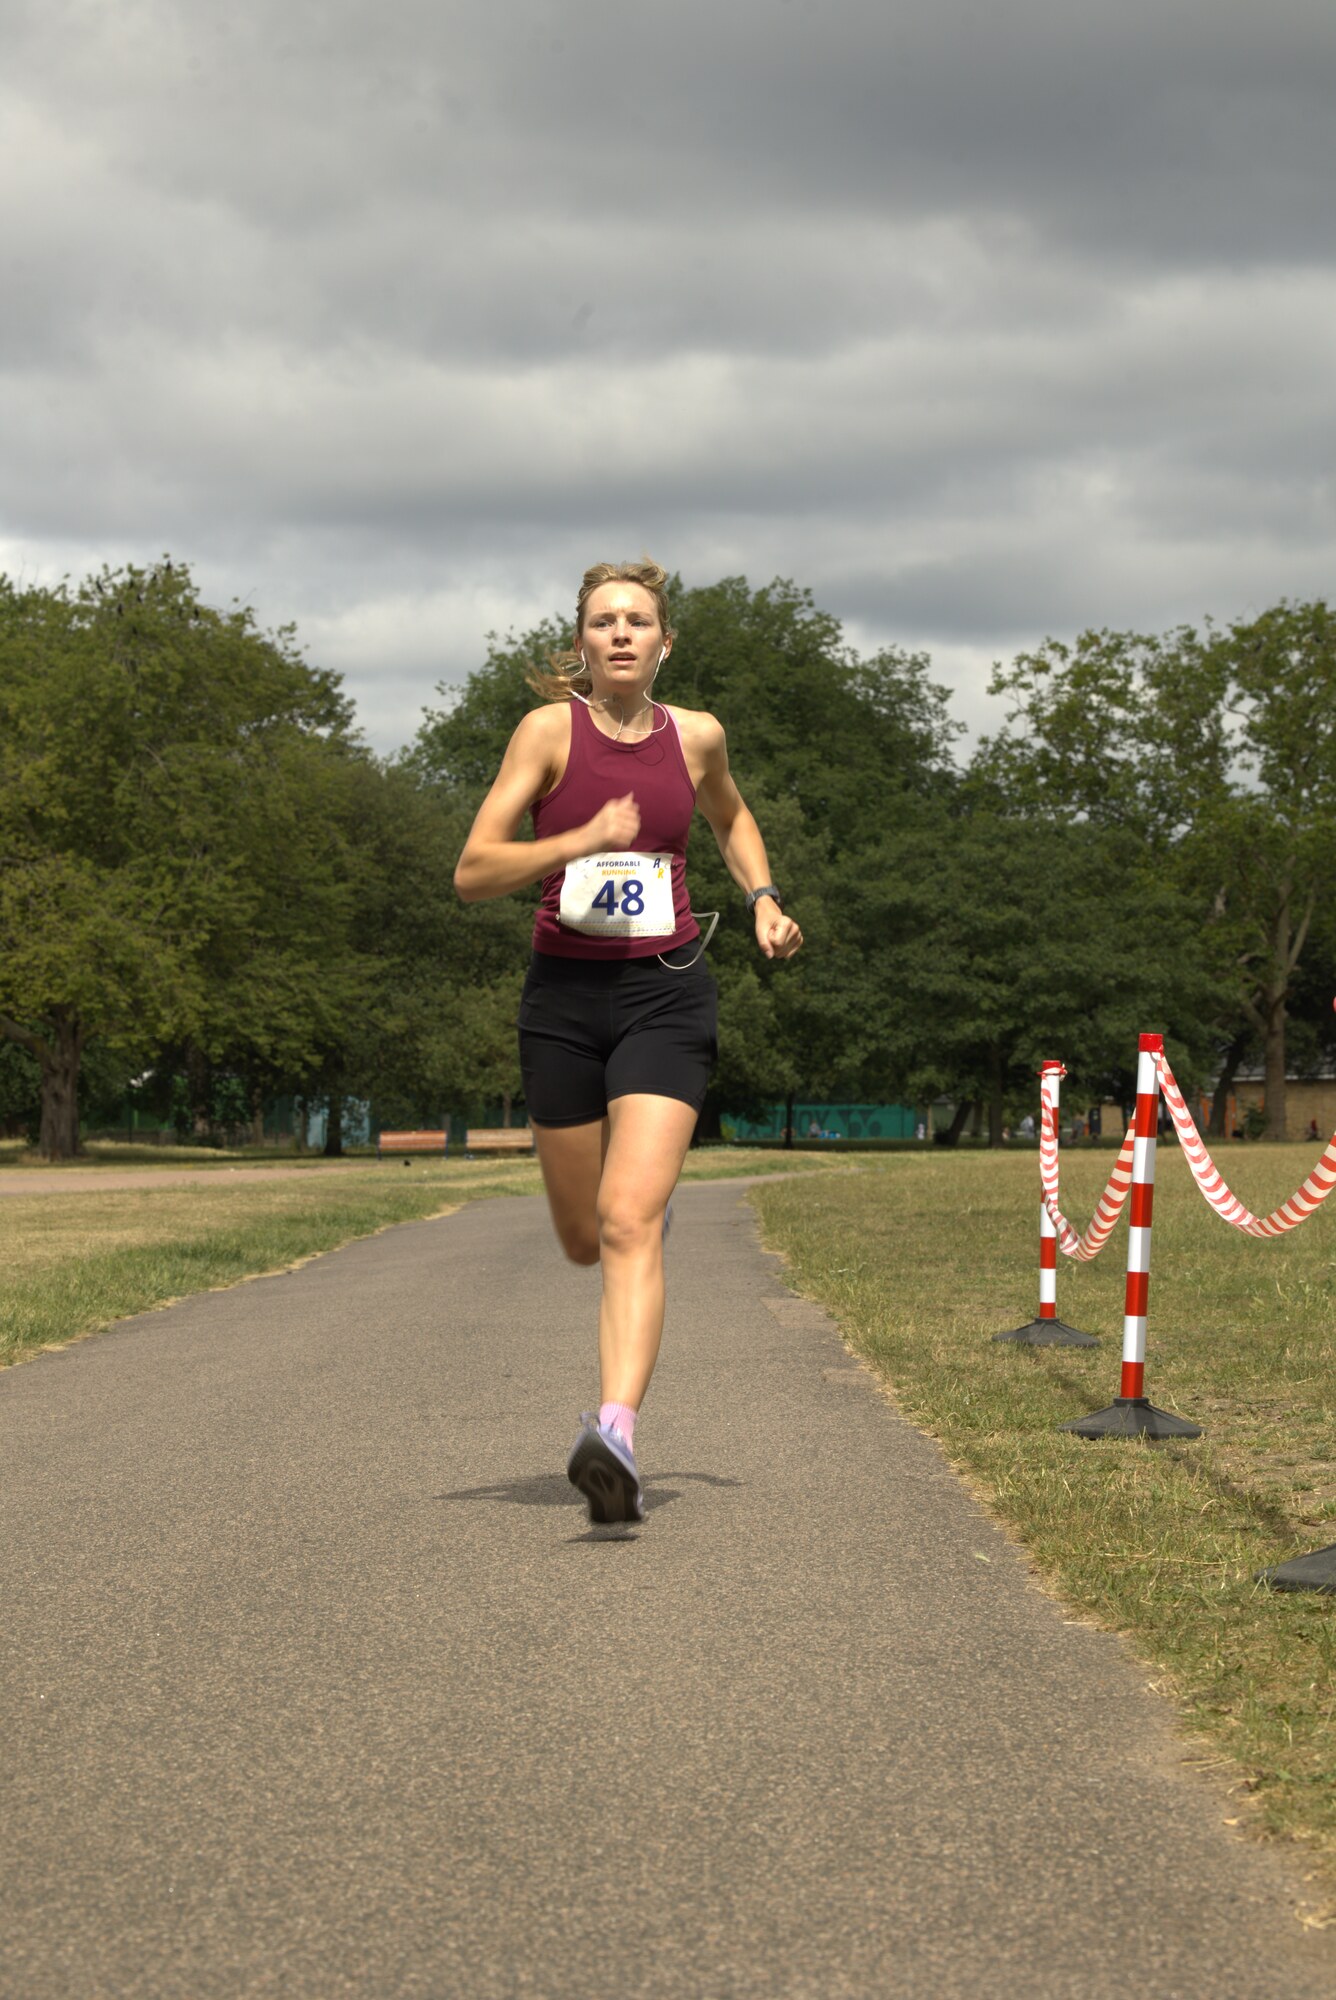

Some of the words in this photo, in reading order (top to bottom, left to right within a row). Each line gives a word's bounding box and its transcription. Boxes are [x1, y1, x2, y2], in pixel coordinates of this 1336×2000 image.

[596, 860, 641, 868] AFFORDABLE
[653, 858, 661, 868] A
[592, 879, 644, 916] 48
